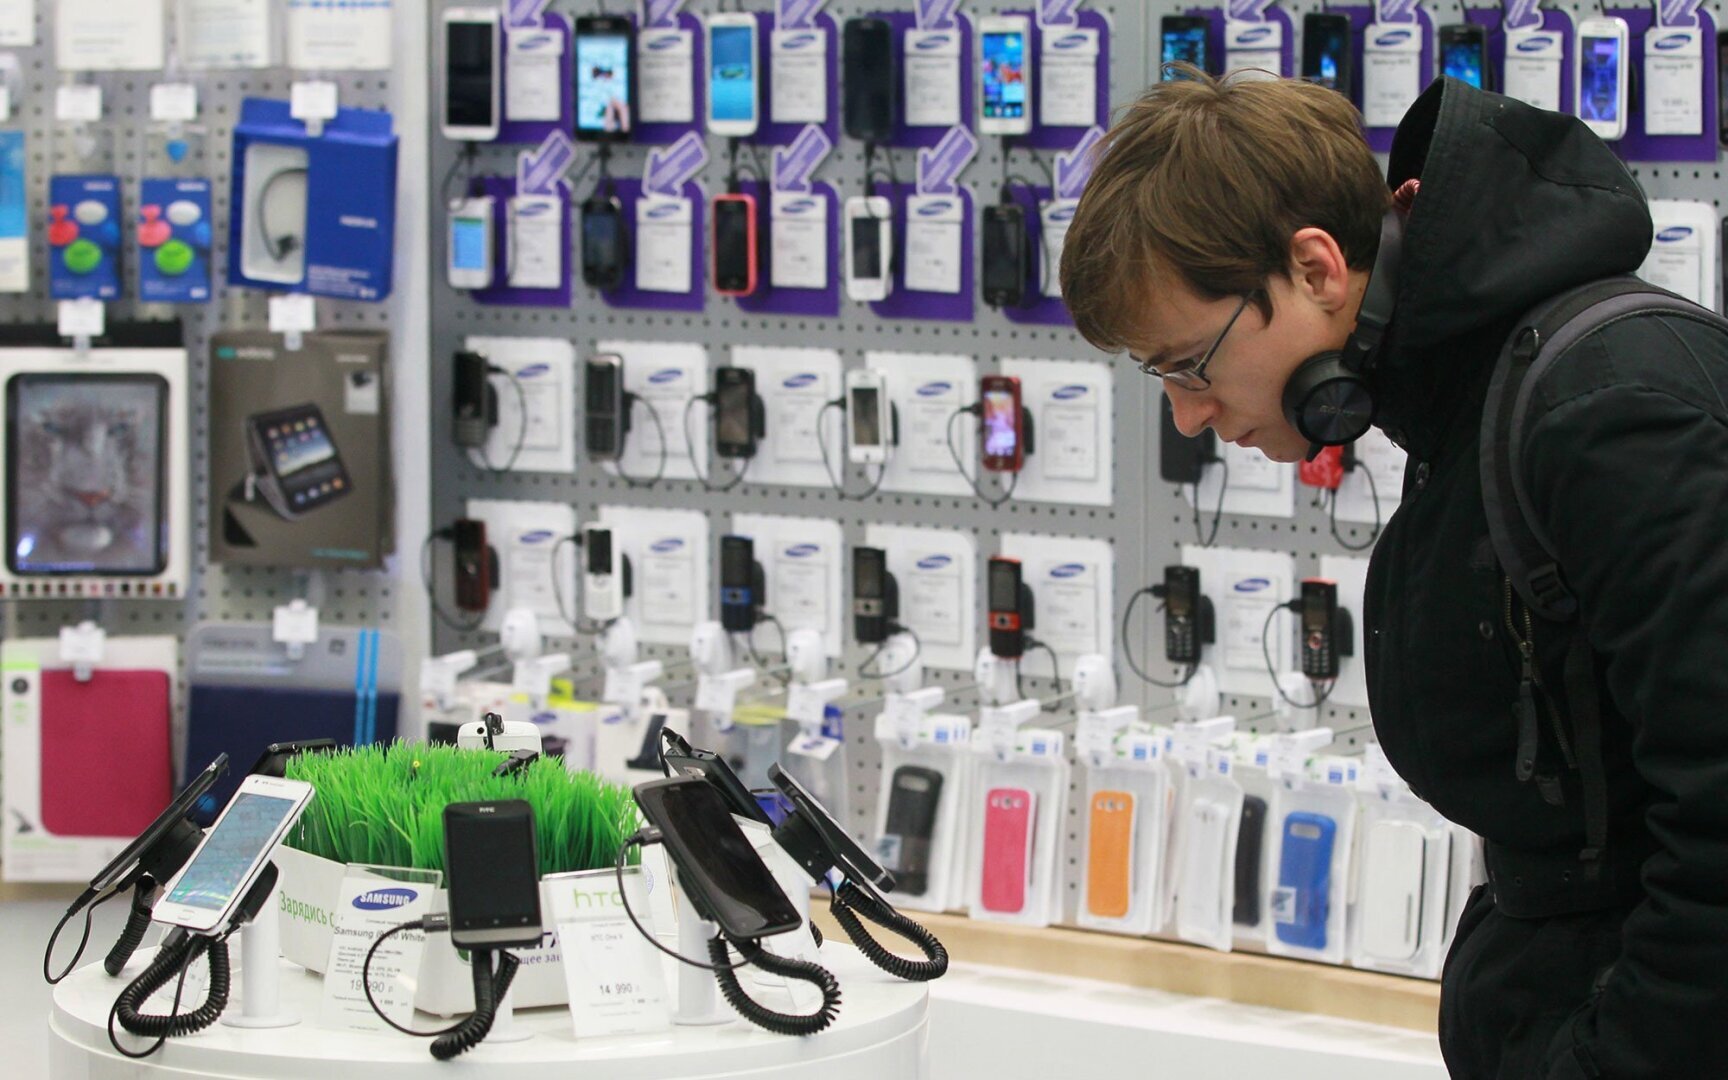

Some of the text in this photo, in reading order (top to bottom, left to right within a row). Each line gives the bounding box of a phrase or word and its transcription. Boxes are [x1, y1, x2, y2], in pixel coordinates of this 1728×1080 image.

[360, 892, 410, 906] SAMSUNG
[280, 890, 328, 925] Зарядись
[334, 926, 426, 943] Samsung i900 White
[351, 979, 362, 991] 19
[600, 983, 632, 994] 14 990
